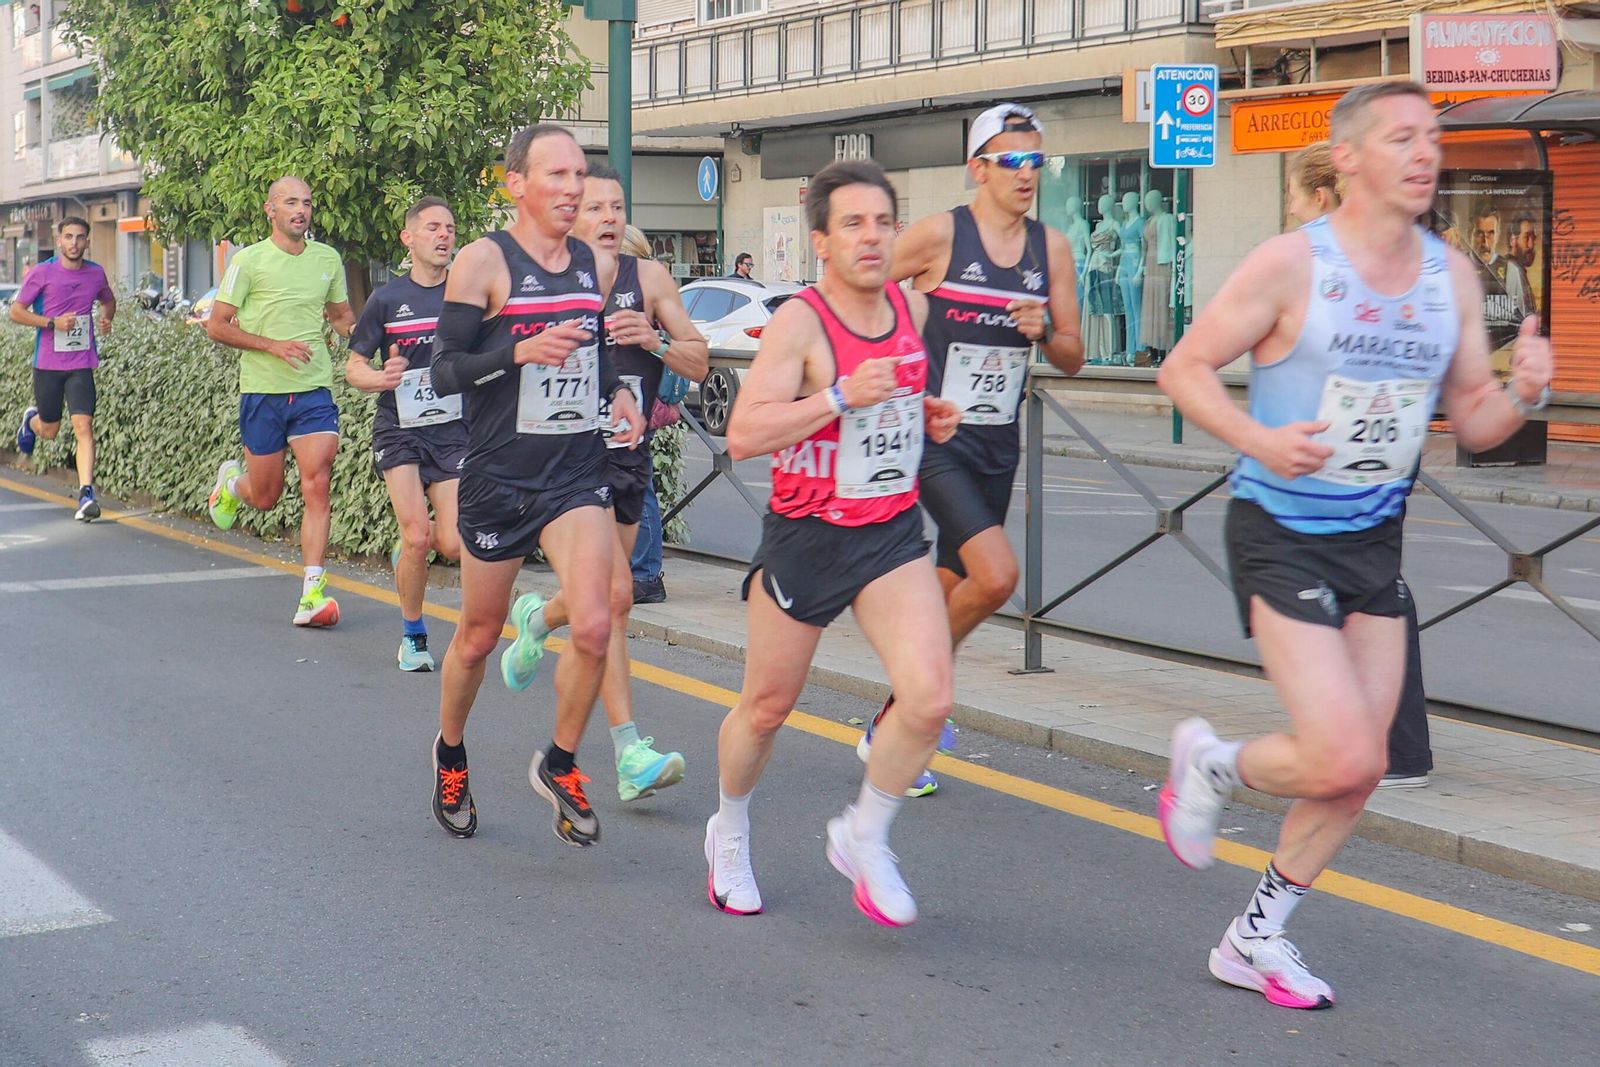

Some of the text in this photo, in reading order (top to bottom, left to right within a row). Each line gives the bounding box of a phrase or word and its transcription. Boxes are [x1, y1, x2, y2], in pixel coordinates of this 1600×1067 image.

[1188, 95, 1206, 105] 30
[1327, 332, 1442, 361] MARACENA
[541, 375, 590, 398] 1771
[970, 372, 1006, 393] 758
[414, 387, 436, 402] 43
[1350, 418, 1398, 443] 206
[861, 428, 913, 458] 1941
